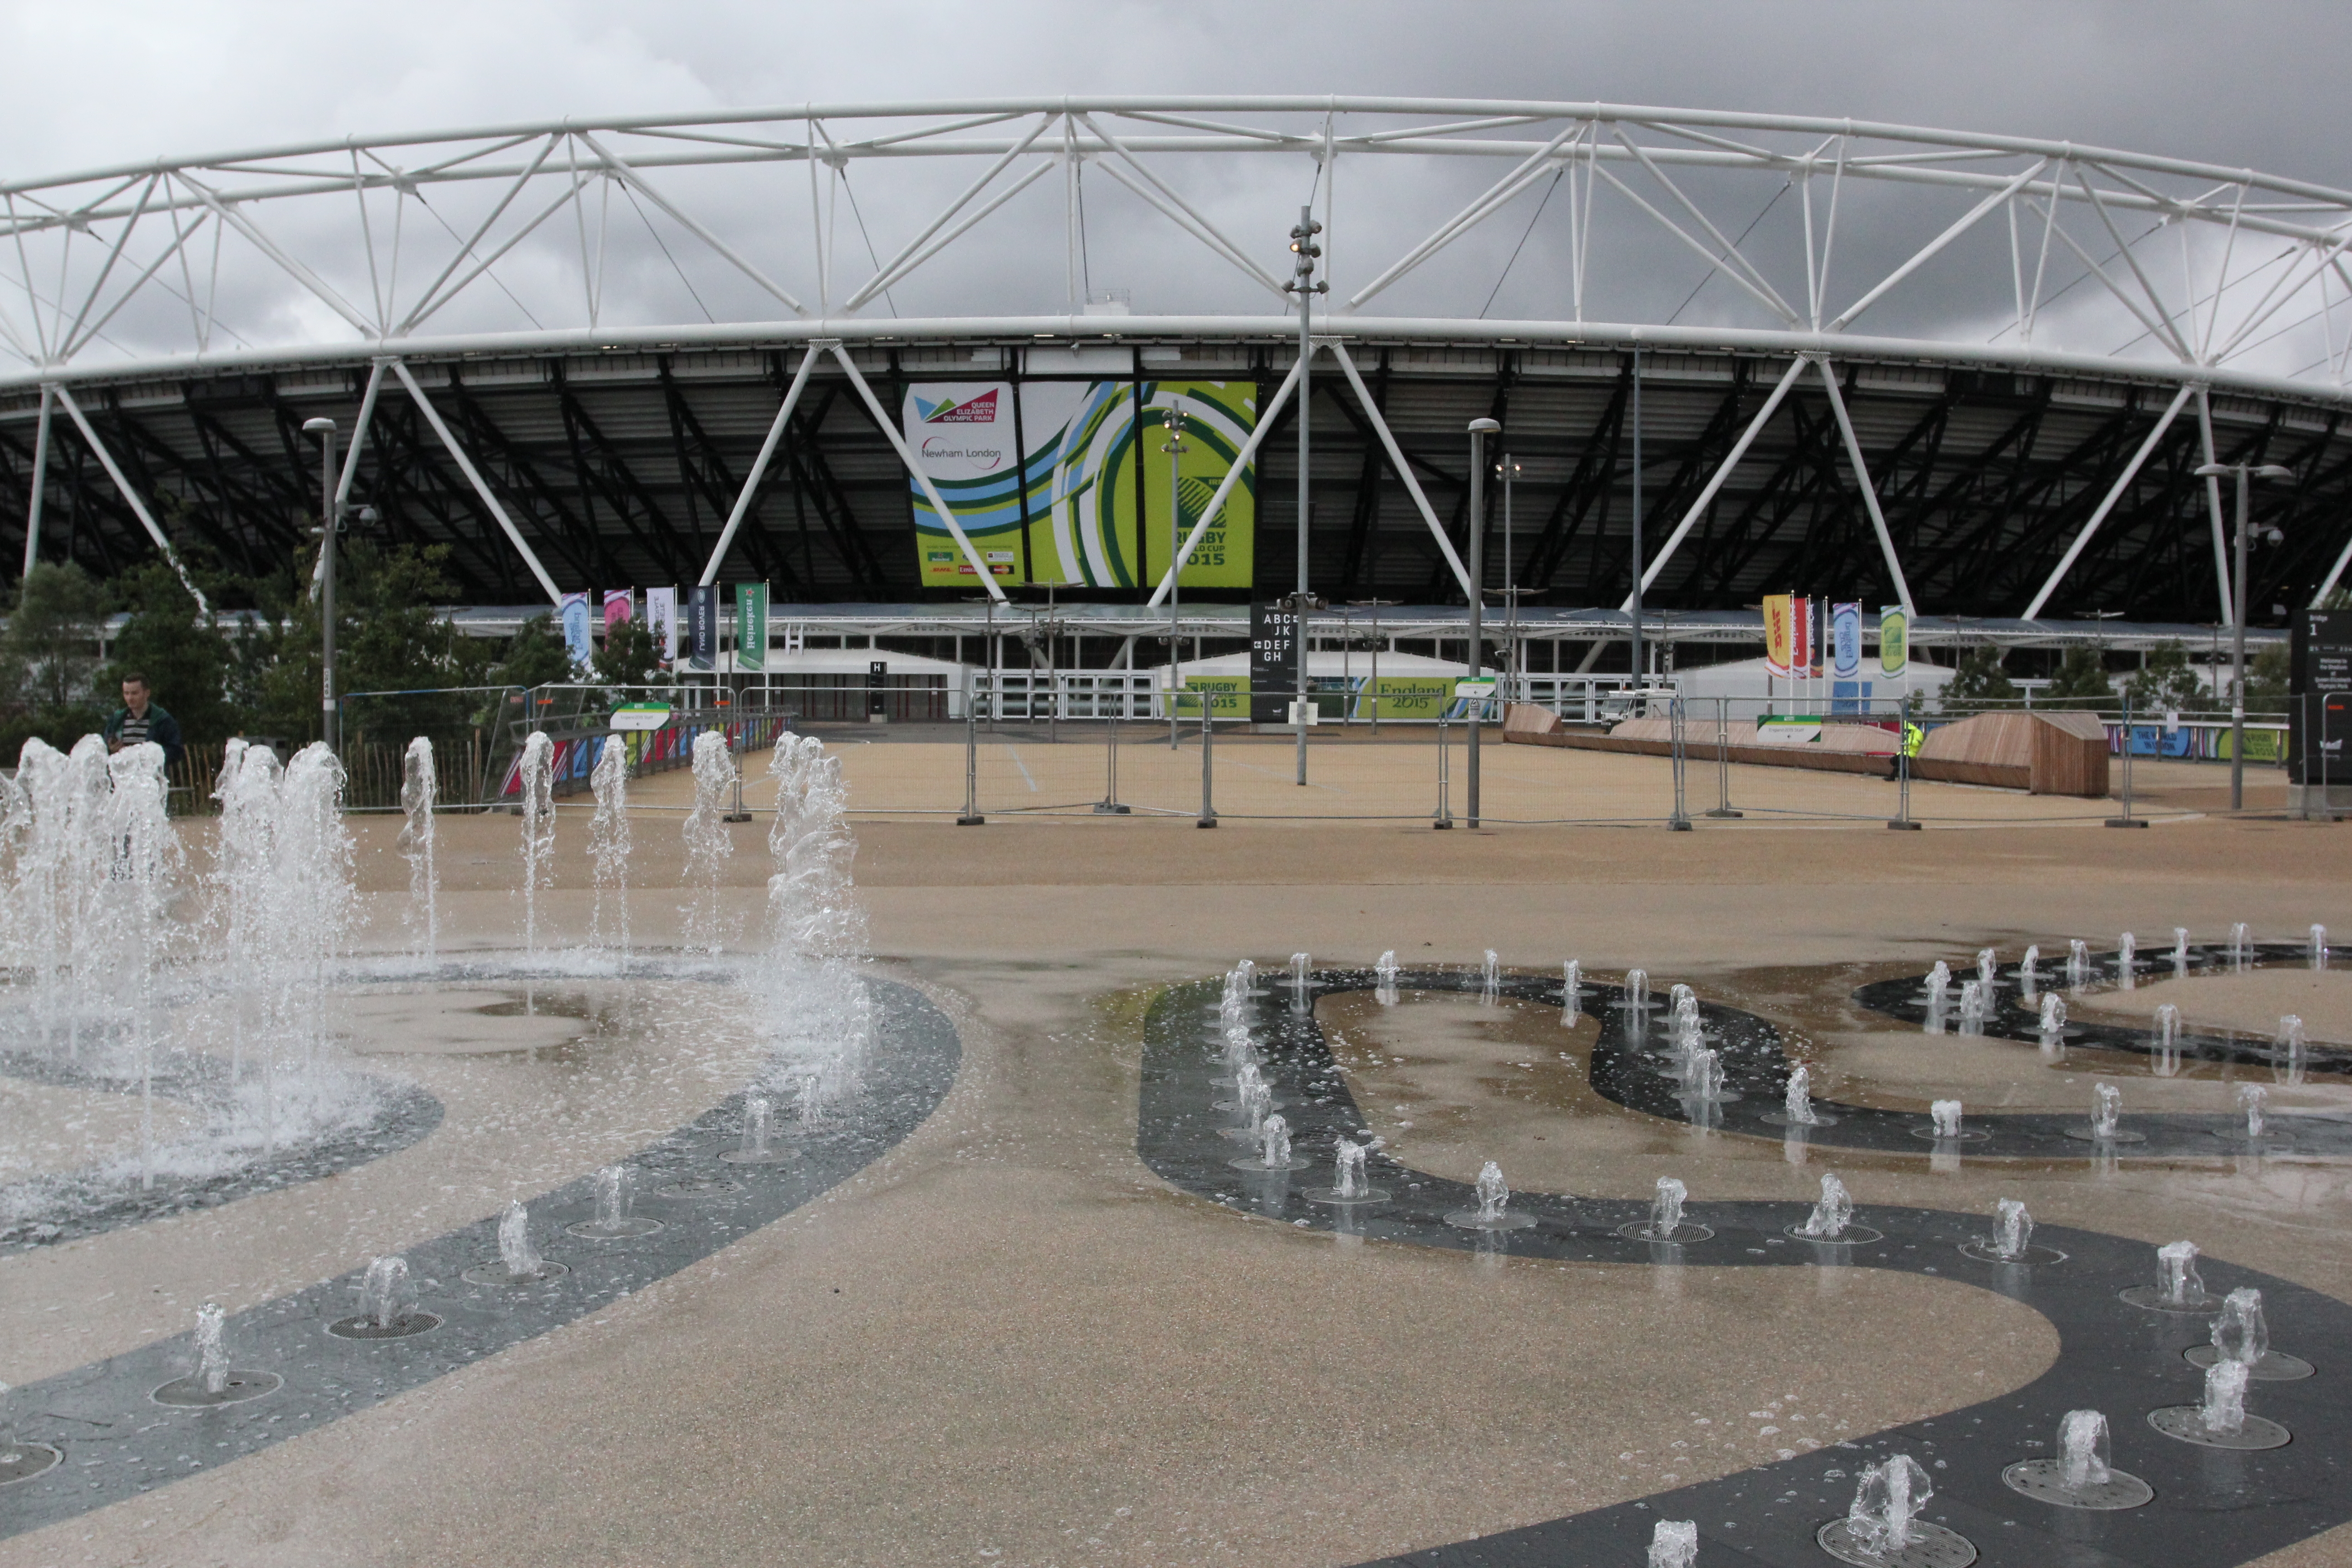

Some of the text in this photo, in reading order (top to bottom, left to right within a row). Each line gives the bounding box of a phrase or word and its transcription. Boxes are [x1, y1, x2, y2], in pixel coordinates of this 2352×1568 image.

[922, 449, 1001, 457] Newham London
[1186, 553, 1225, 565] 015
[2310, 623, 2317, 635] 1
[874, 663, 880, 671] H
[1200, 682, 1237, 691] RUGBY
[1380, 683, 1446, 697] England
[1201, 699, 1237, 708] 015
[1392, 696, 1429, 708] 2015
[2151, 732, 2177, 740] WRLD
